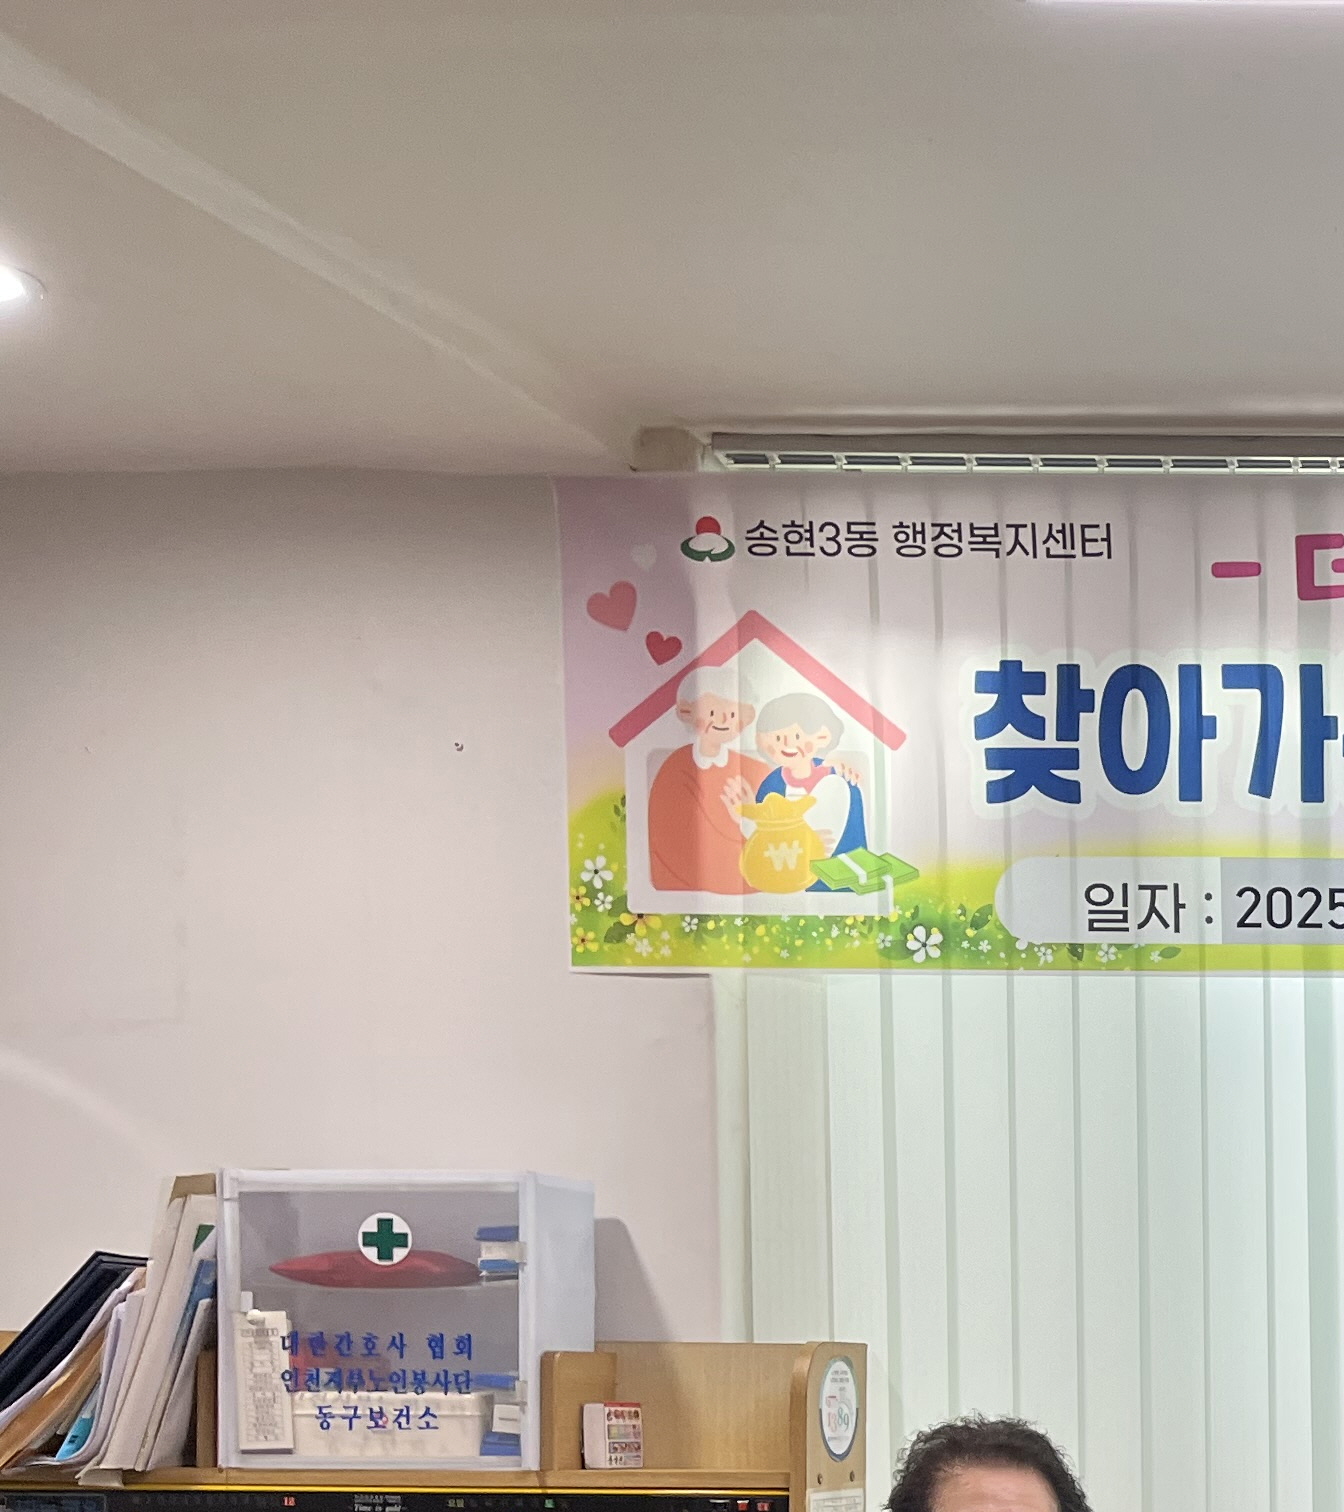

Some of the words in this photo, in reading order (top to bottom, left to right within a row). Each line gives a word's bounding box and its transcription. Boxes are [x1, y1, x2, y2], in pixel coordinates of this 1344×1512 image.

[745, 519, 880, 560] 송현3동
[892, 520, 1114, 562] 행정복지센터
[1084, 883, 1187, 934] 일자
[426, 1332, 474, 1361] 협회
[315, 1404, 440, 1431] 동구보건소
